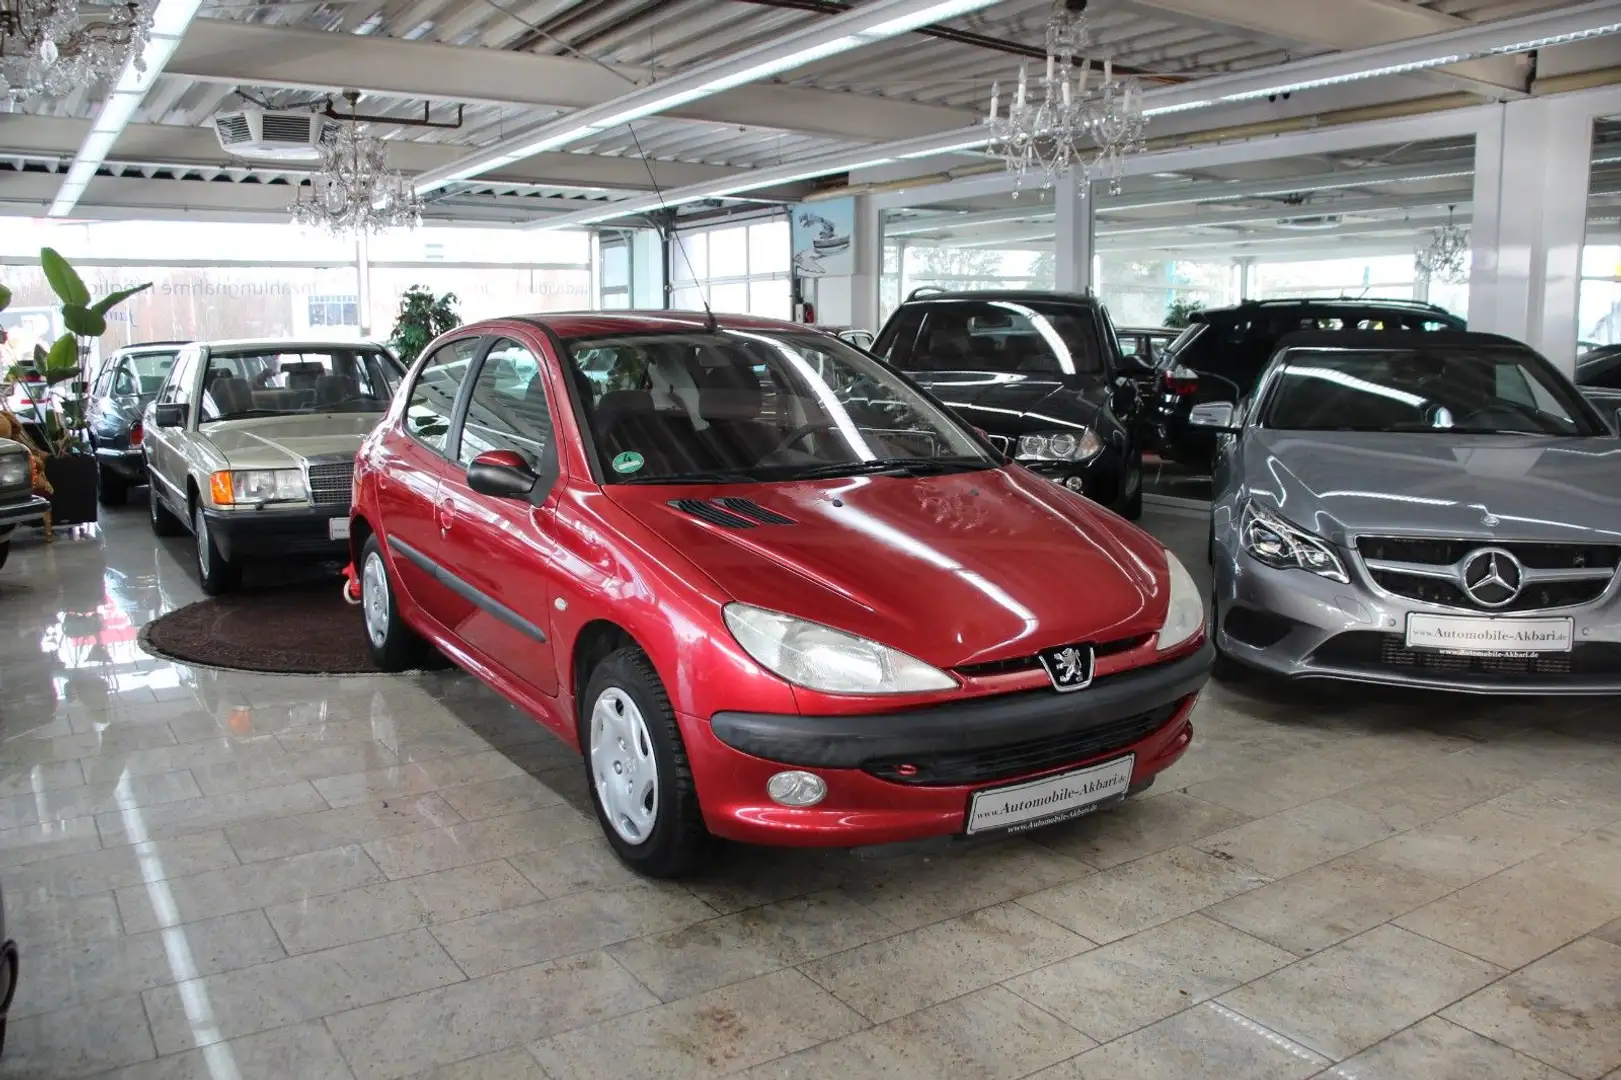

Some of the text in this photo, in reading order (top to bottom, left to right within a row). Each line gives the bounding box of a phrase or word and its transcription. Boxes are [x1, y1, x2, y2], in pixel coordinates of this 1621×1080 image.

[1412, 627, 1567, 642] www.Automobile-Akbari.de
[1439, 648, 1539, 658] www.Automobile-Akbari.de
[976, 772, 1127, 819] www.Automobile-Akbari.de
[1007, 803, 1098, 833] www.Automobile-Akbari.de
